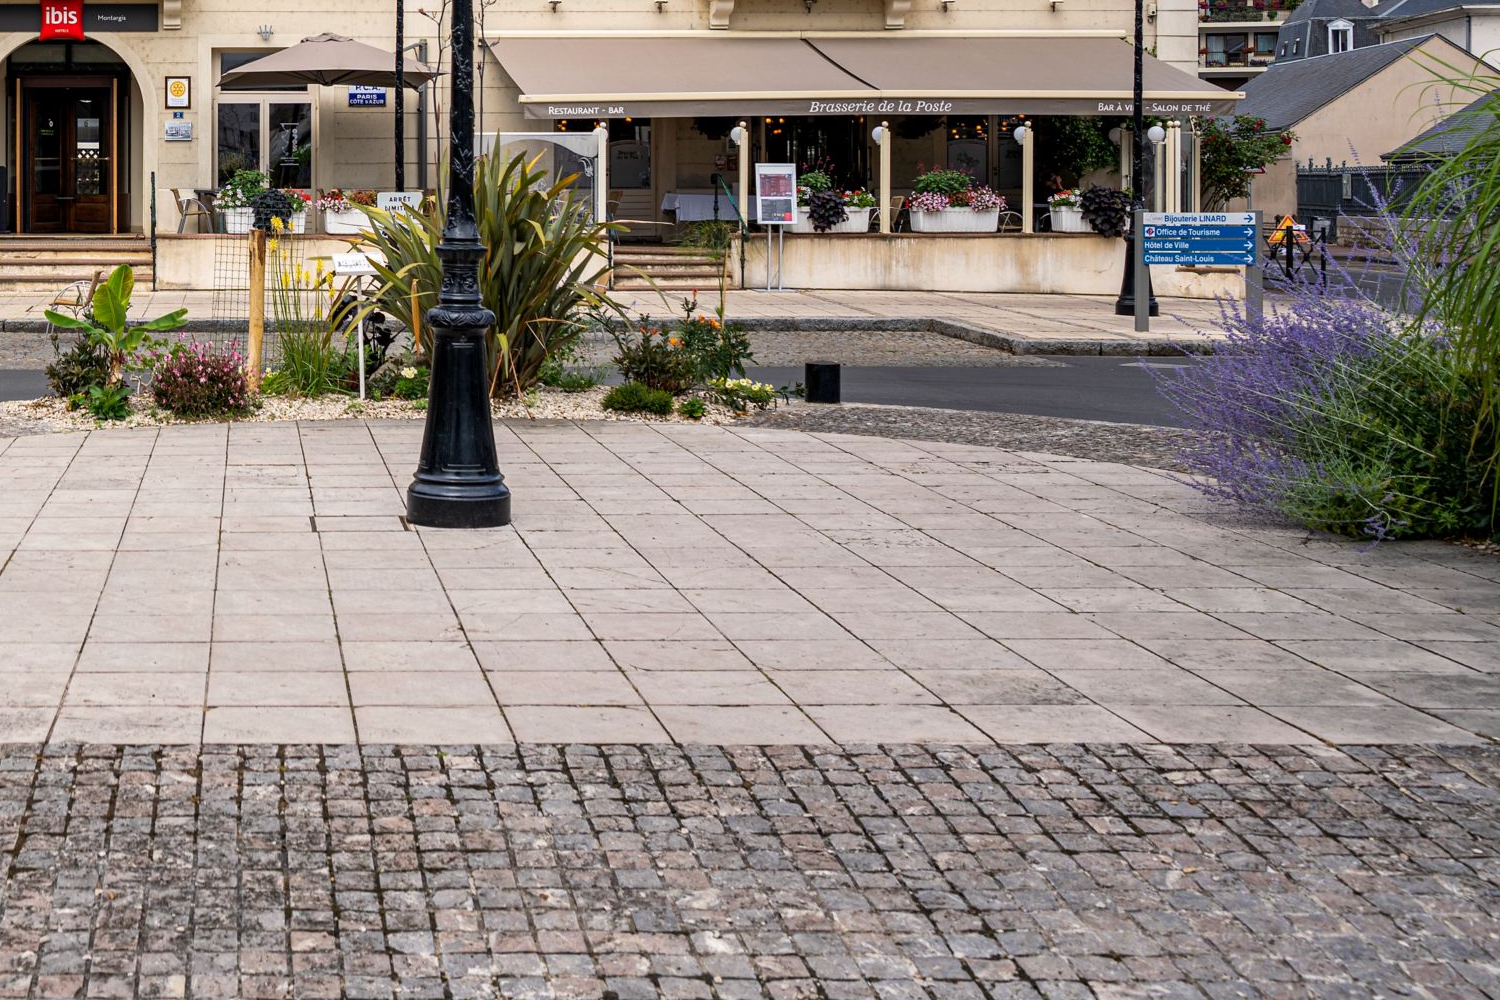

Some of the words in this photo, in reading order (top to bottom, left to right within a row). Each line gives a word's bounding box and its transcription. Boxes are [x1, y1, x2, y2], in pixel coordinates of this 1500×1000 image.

[45, 6, 78, 25] ibis
[97, 14, 127, 22] Montargis
[548, 106, 600, 115] RESTAURANT
[809, 100, 875, 113] Brasserie
[878, 100, 895, 112] de
[898, 100, 912, 112] la
[915, 100, 952, 112] Poste
[1097, 102, 1114, 111] BAR
[1152, 102, 1179, 111] SALON
[1194, 102, 1211, 111] THÉ
[1164, 214, 1198, 223] Bijouterie
[1199, 215, 1227, 223] LINARD
[1144, 241, 1163, 249] Hôtel
[1164, 241, 1174, 249] de
[1174, 241, 1189, 249] Ville
[1144, 254, 1174, 262] Château
[1174, 254, 1215, 262] Saint-Louis
